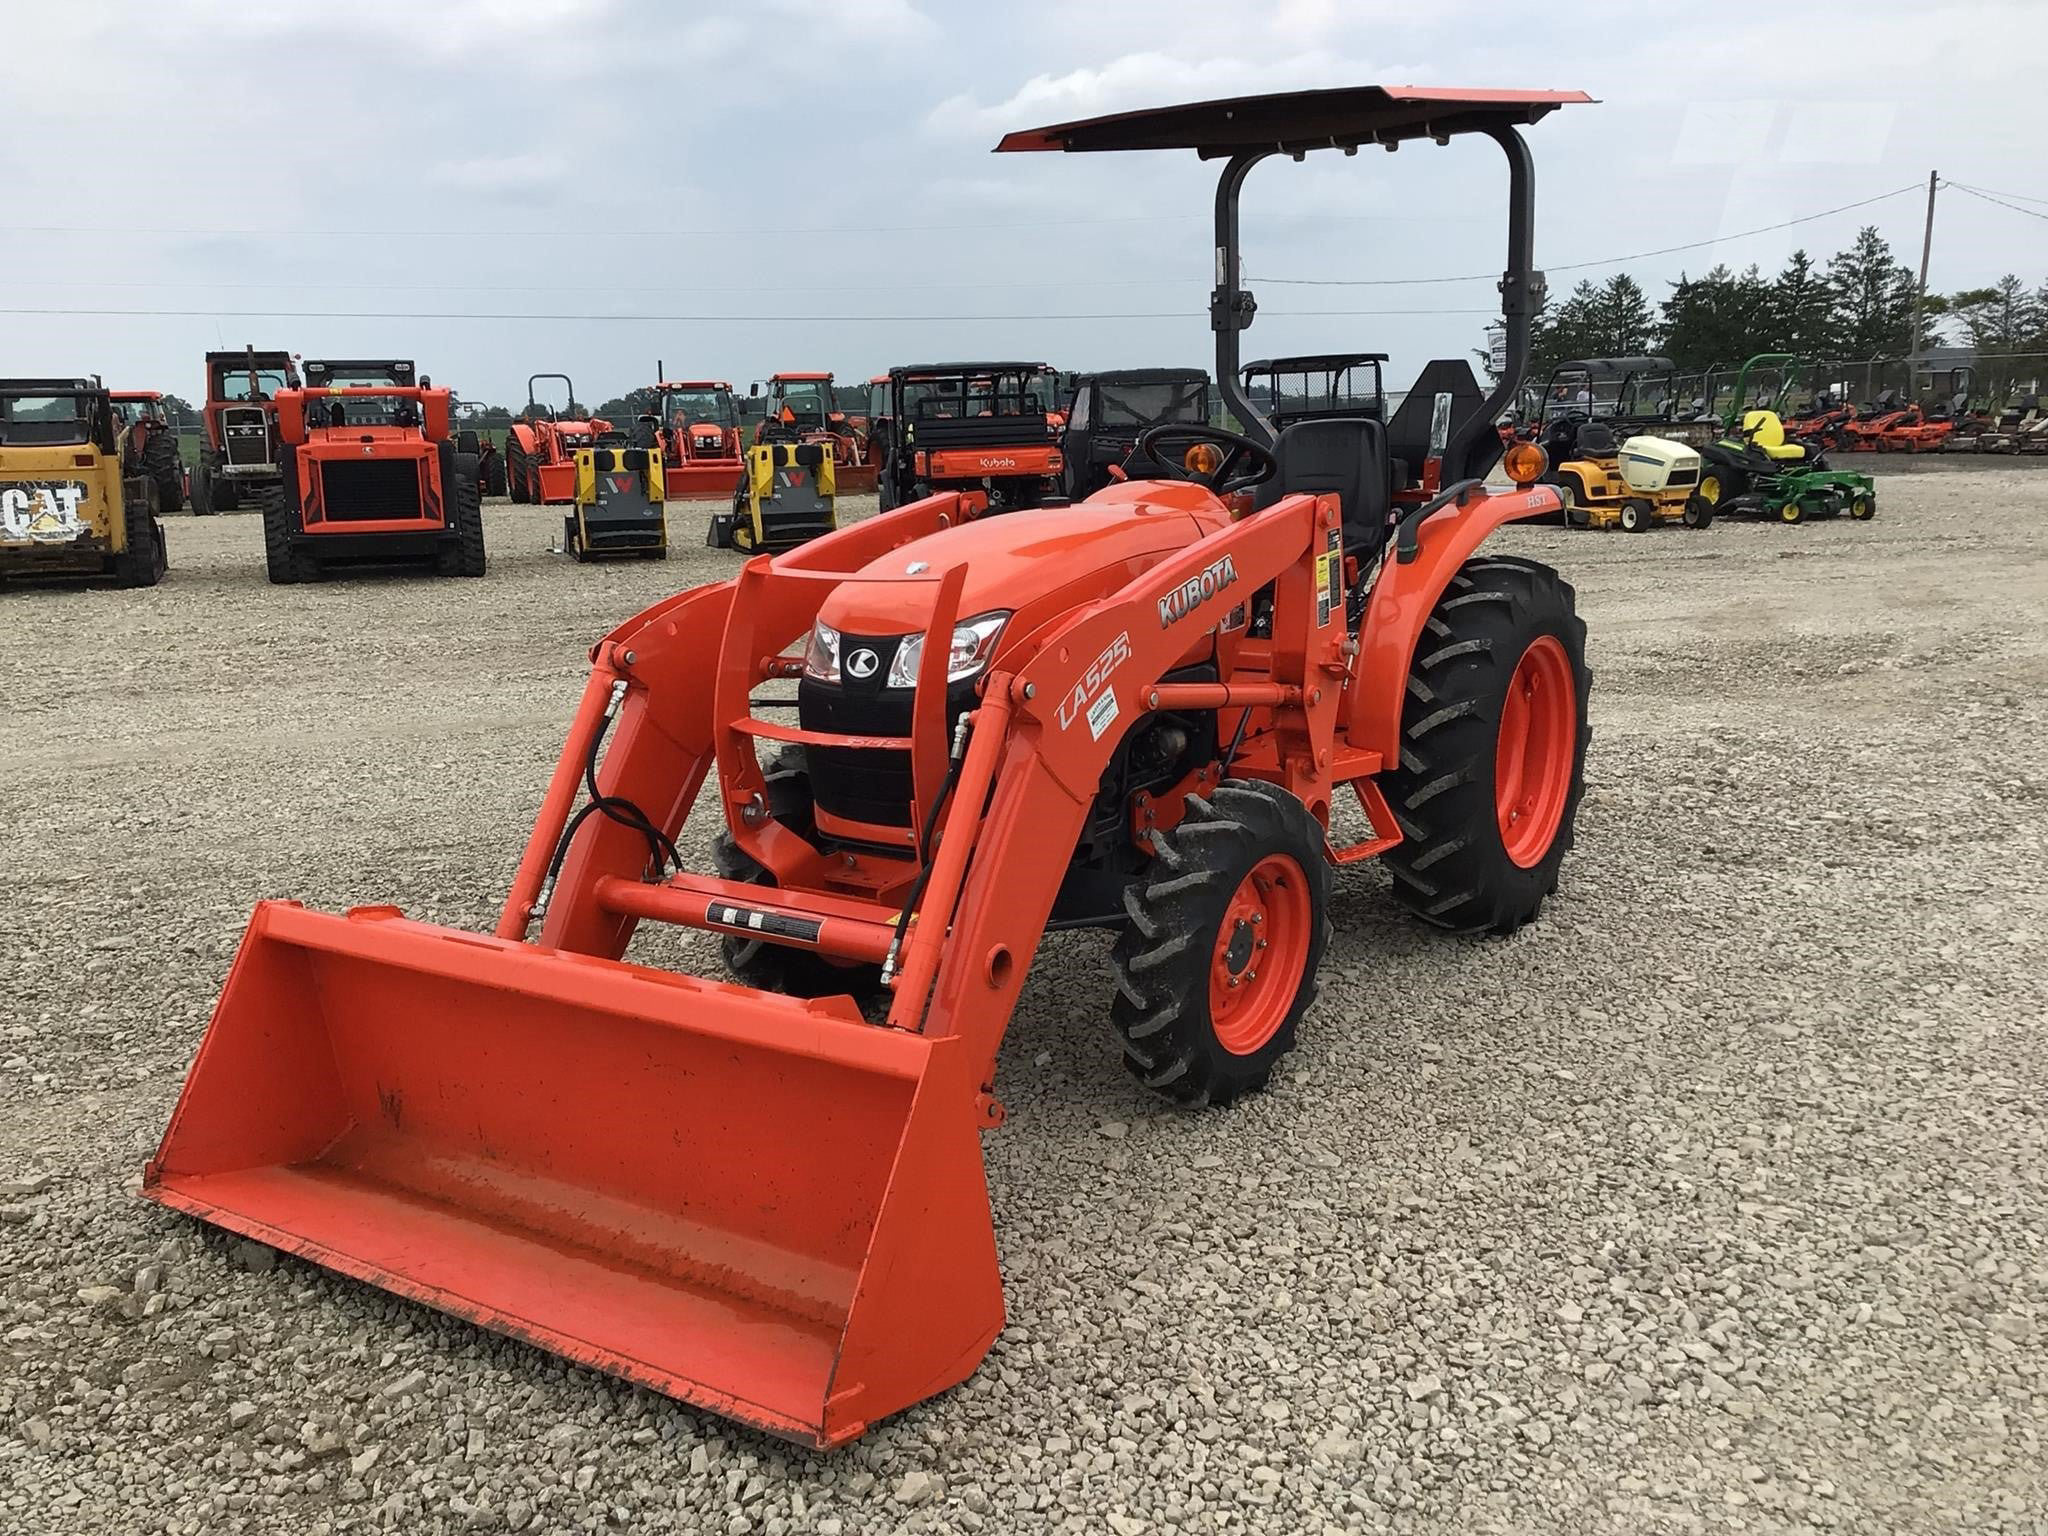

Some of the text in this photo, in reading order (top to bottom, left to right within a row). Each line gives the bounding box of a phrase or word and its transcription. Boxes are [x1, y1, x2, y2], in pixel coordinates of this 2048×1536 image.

[979, 457, 1015, 468] Kubota
[2, 488, 82, 537] CAT
[1527, 495, 1547, 508] HST
[1159, 555, 1238, 629] KUBOTA
[1059, 635, 1129, 730] LA525
